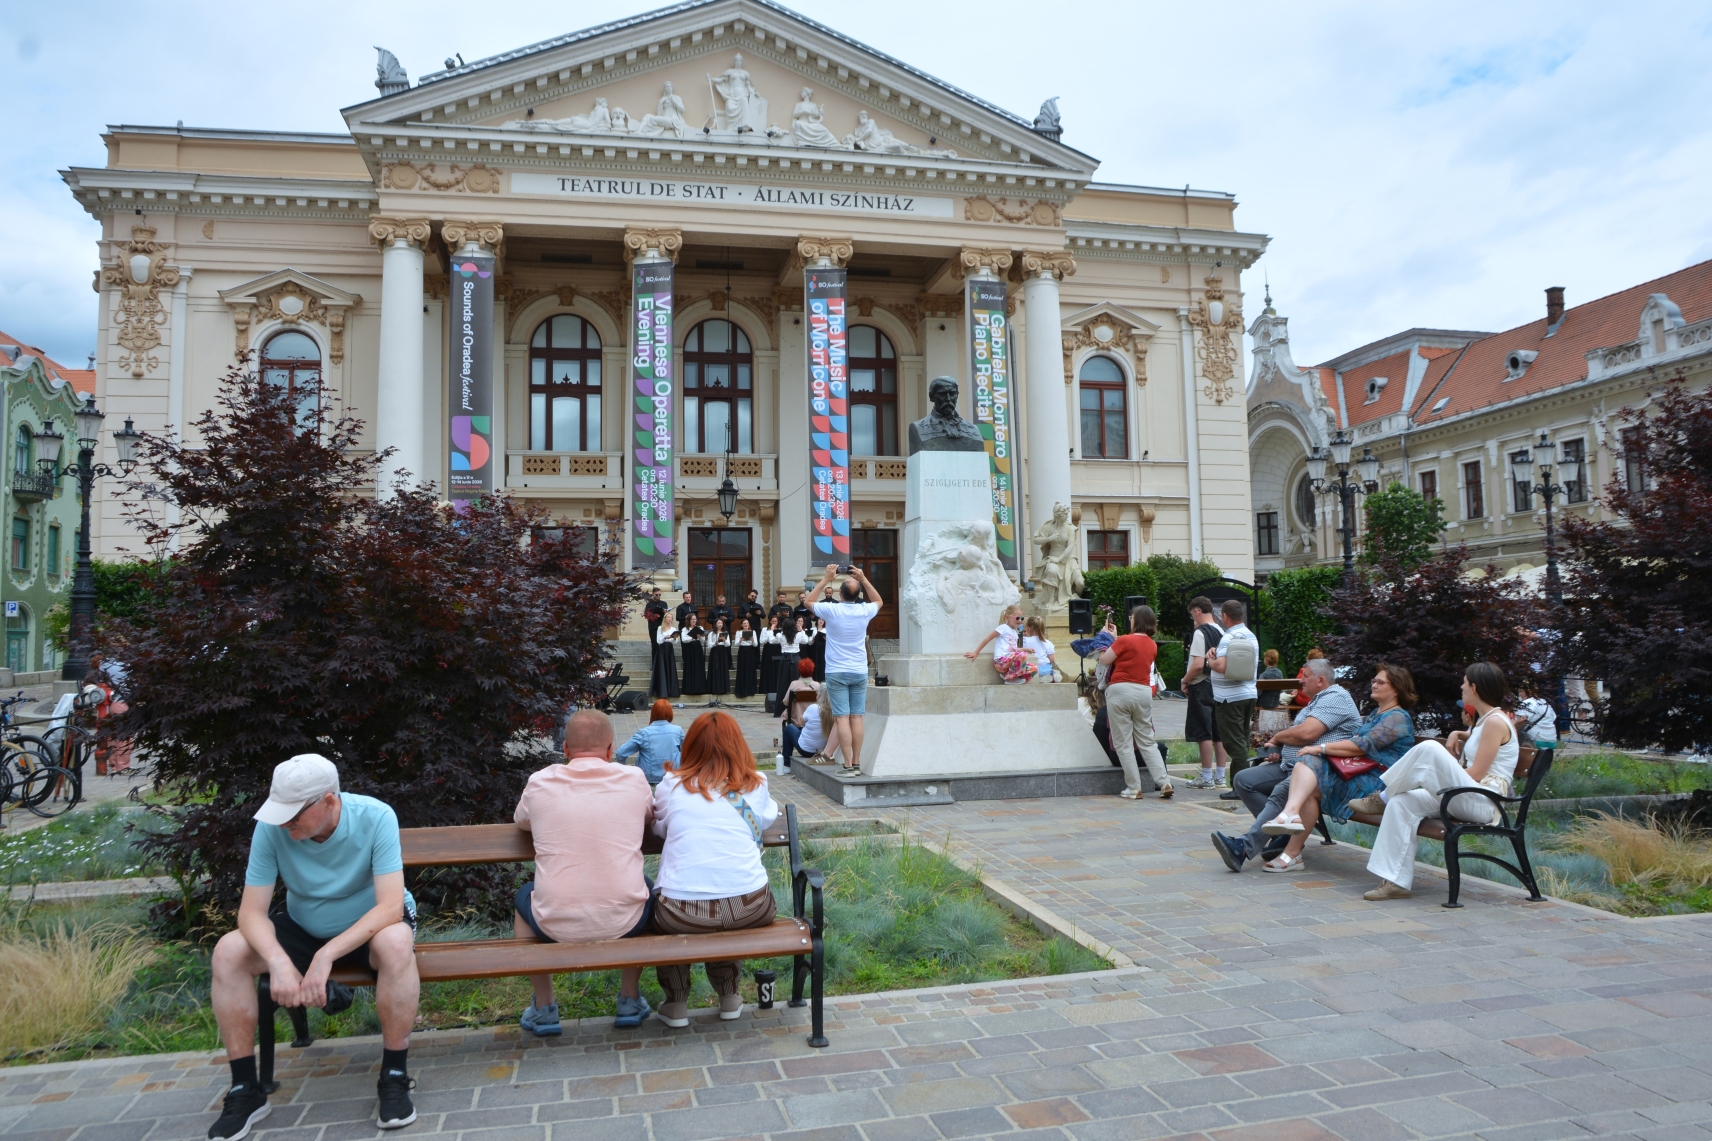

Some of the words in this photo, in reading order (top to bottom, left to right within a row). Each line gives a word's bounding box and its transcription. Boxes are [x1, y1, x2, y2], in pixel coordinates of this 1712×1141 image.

[557, 178, 646, 195] TEATRUL
[650, 182, 676, 197] DE
[682, 184, 728, 199] STAT
[753, 185, 824, 205] ÁLLAMI
[830, 191, 915, 212] SZÍNHÁZ
[463, 281, 474, 322] Sounds
[812, 302, 828, 320] of
[463, 323, 474, 335] of
[634, 297, 654, 367] Evening
[829, 301, 845, 335] The
[655, 295, 672, 378] Viennese
[975, 313, 990, 360] Piano
[991, 314, 1006, 383] Gabriela
[462, 336, 474, 375] Oradea
[812, 323, 829, 412] Morricone
[829, 339, 847, 391] Music
[460, 374, 474, 410] festival
[976, 363, 993, 421] Recital
[651, 380, 672, 461] Operetta
[993, 386, 1008, 458] Montero
[641, 469, 650, 501] Cetatea
[659, 469, 667, 478] 12
[659, 479, 667, 499] iunie
[819, 470, 827, 501] Cetatea
[835, 470, 844, 479] 13
[972, 479, 988, 488] EDE
[999, 476, 1007, 485] 14
[650, 484, 658, 508] 20:30
[827, 484, 836, 508] 20:30
[836, 480, 844, 499] iunie
[1000, 486, 1008, 505] iunie
[641, 502, 650, 531] Oradea
[659, 500, 667, 522] 2026
[820, 501, 828, 530] Oradea
[836, 501, 845, 521] 2026
